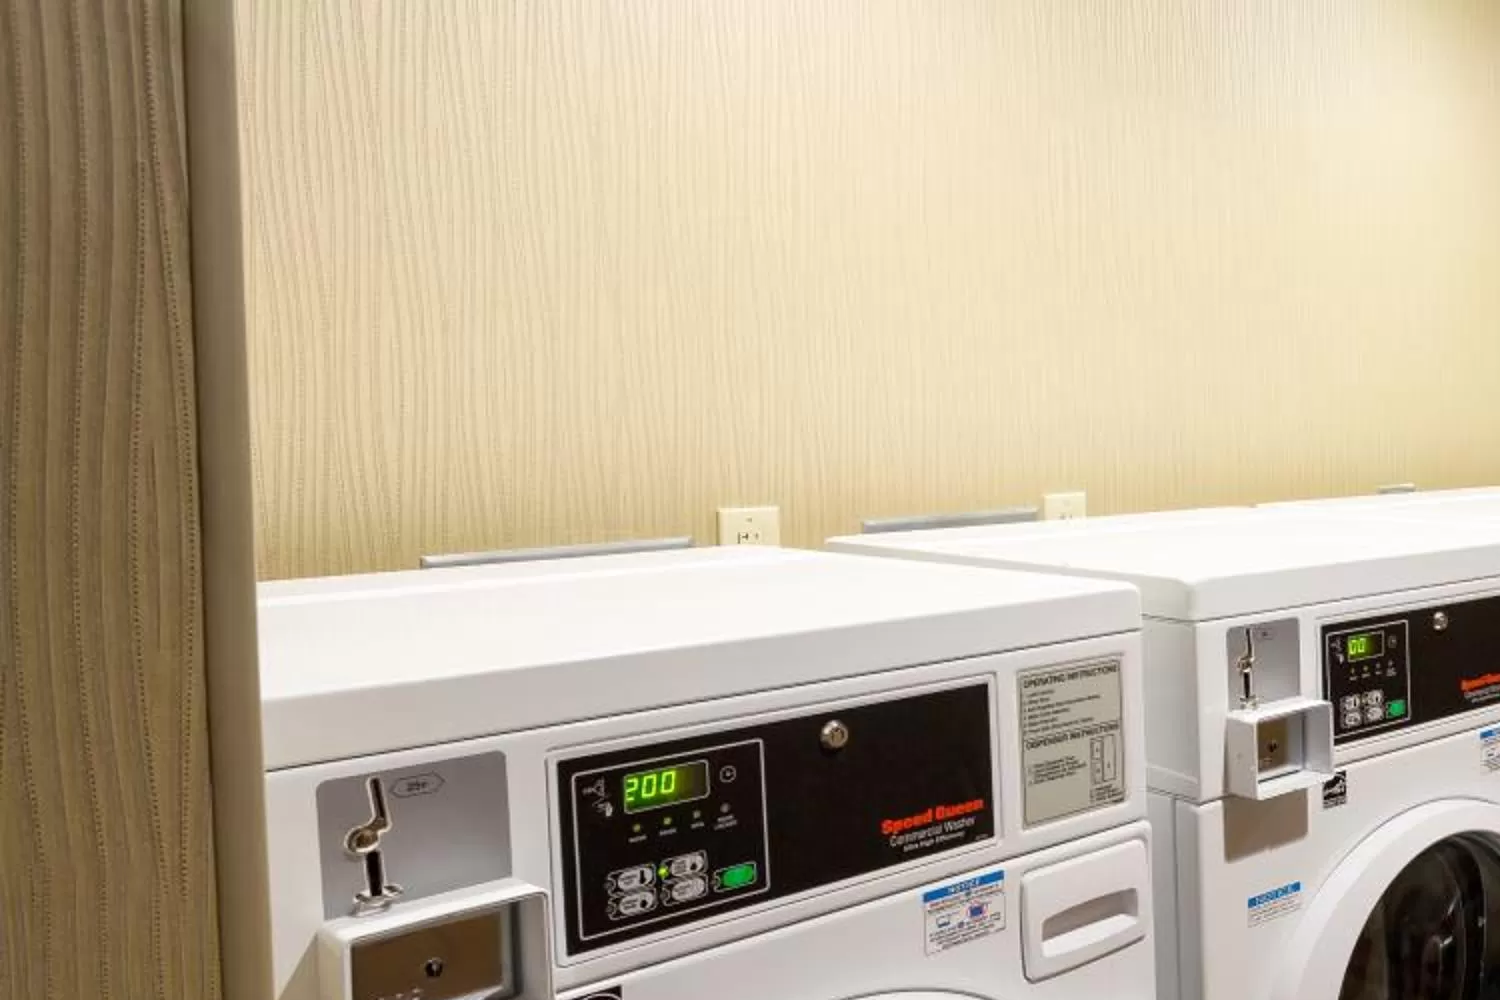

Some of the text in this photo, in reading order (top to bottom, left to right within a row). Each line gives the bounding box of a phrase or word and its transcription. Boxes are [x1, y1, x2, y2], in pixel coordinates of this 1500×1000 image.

[625, 770, 676, 802] 200
[881, 799, 984, 835] Speed Queen
